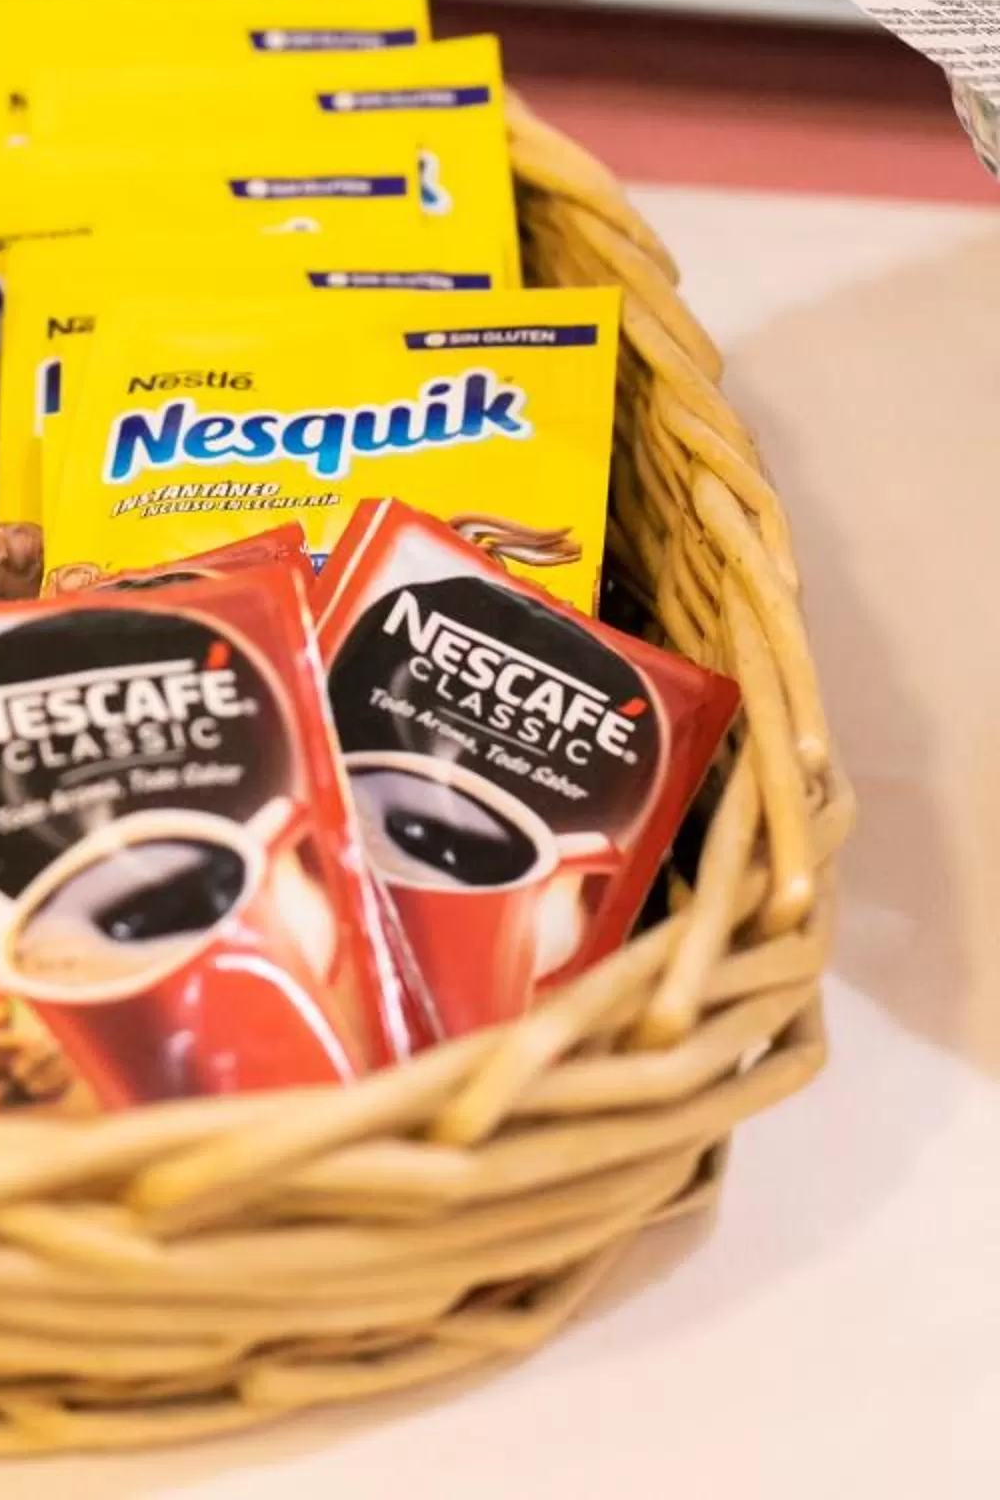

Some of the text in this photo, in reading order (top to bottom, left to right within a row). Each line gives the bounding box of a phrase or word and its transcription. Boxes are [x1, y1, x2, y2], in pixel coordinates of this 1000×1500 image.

[449, 329, 557, 345] SIN GLUTEN
[108, 372, 525, 481] Nesquik
[381, 589, 648, 757] NESCAFÉ
[408, 655, 593, 766] CLASSIC
[1, 716, 224, 775] CLASSIC
